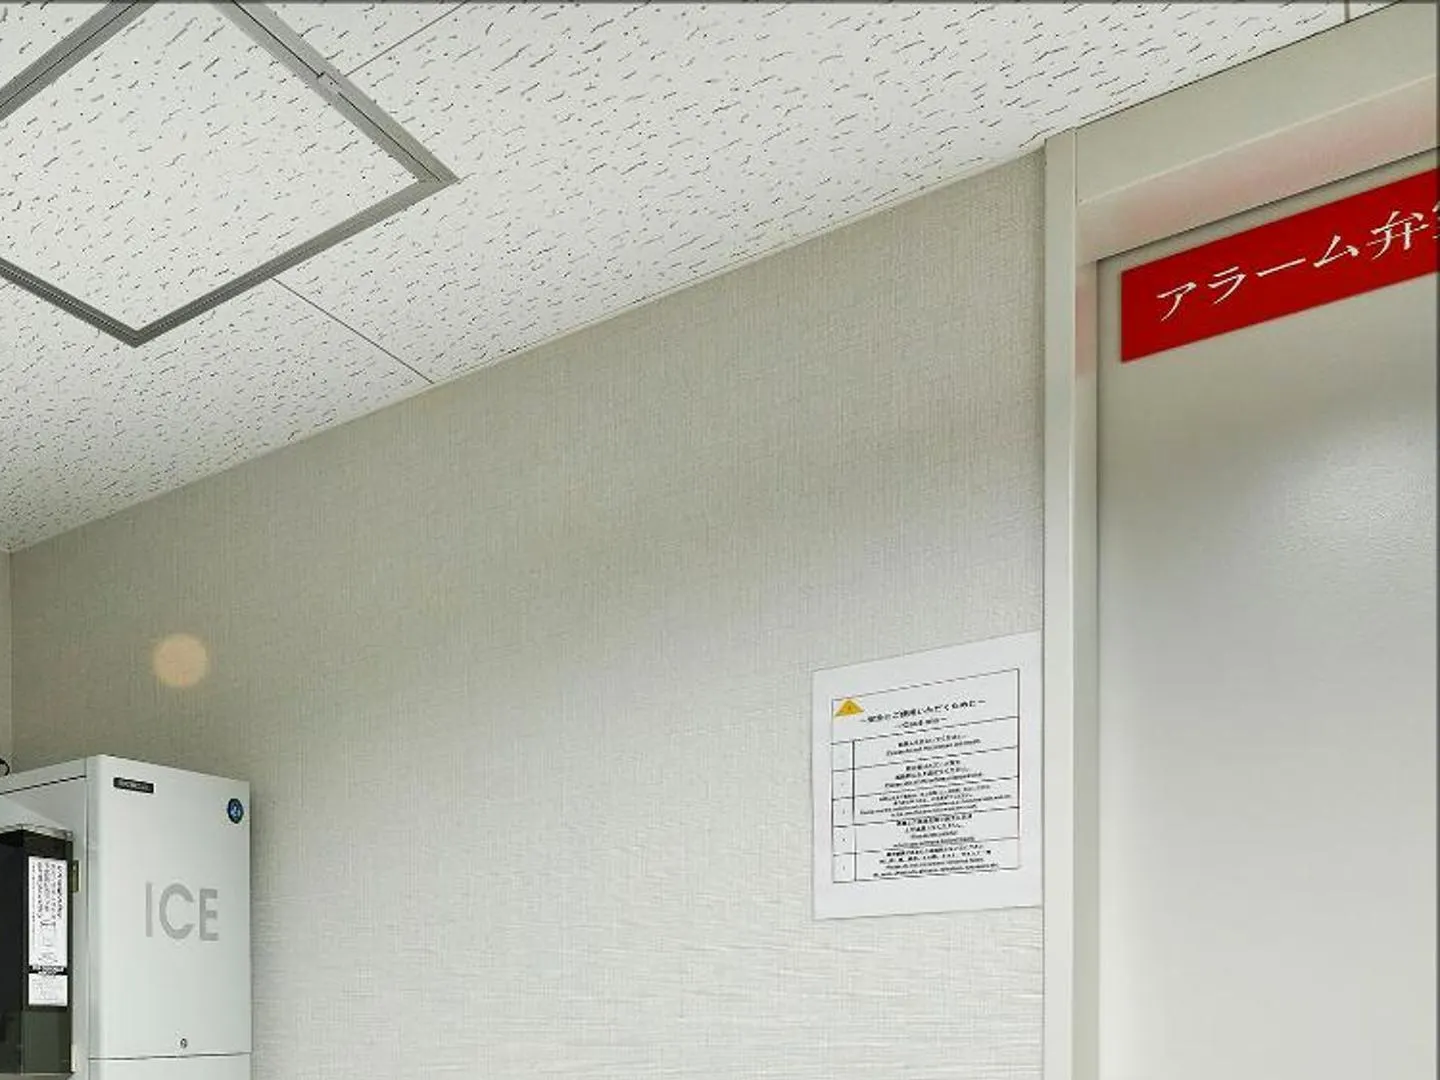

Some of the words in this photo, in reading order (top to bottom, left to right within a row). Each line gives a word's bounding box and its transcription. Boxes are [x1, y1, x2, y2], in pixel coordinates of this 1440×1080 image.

[1157, 199, 1440, 322] アラーム弁
[145, 881, 219, 941] ICE
